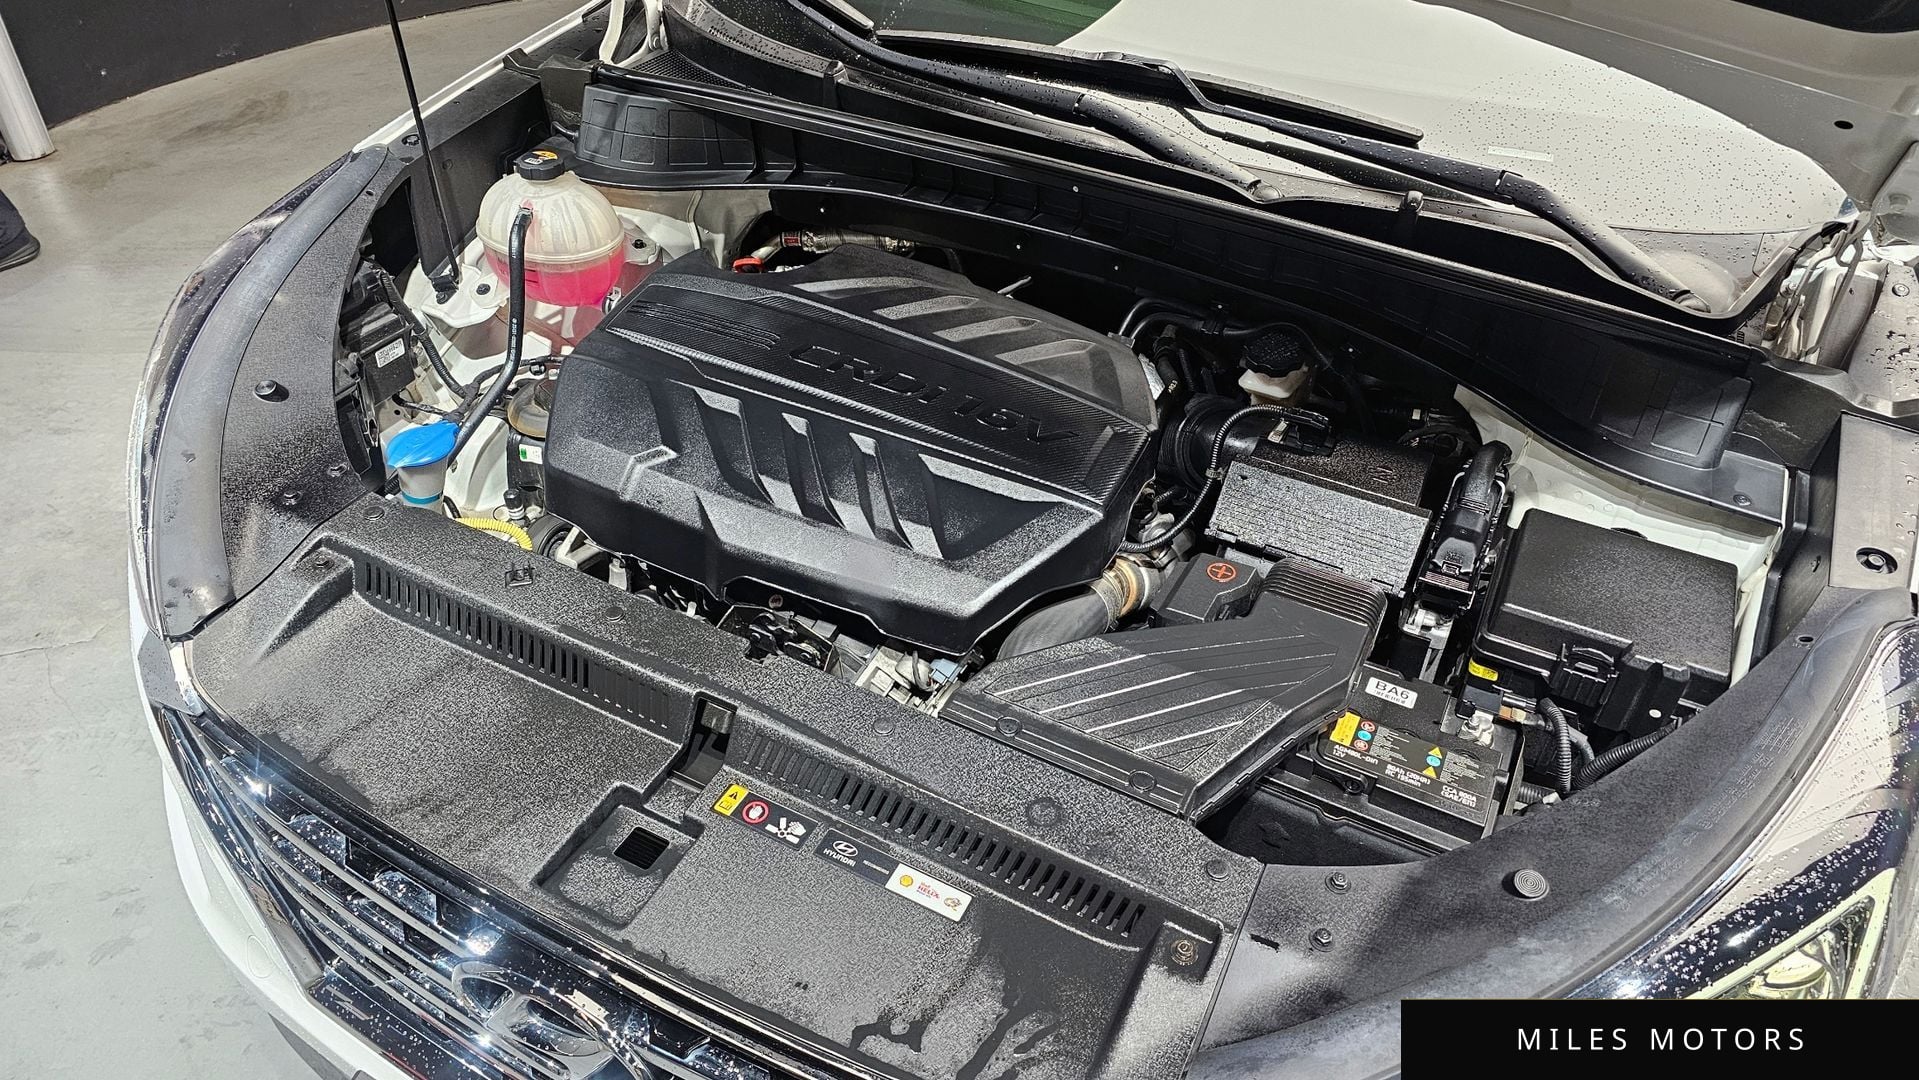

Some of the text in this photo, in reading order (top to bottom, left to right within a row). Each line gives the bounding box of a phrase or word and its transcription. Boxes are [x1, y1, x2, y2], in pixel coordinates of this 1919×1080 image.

[788, 345, 1081, 445] CRDI 16V
[1375, 680, 1410, 700] BA6
[1332, 749, 1346, 758] 12V
[1442, 785, 1457, 795] CCA
[823, 848, 857, 867] HYUNDAI
